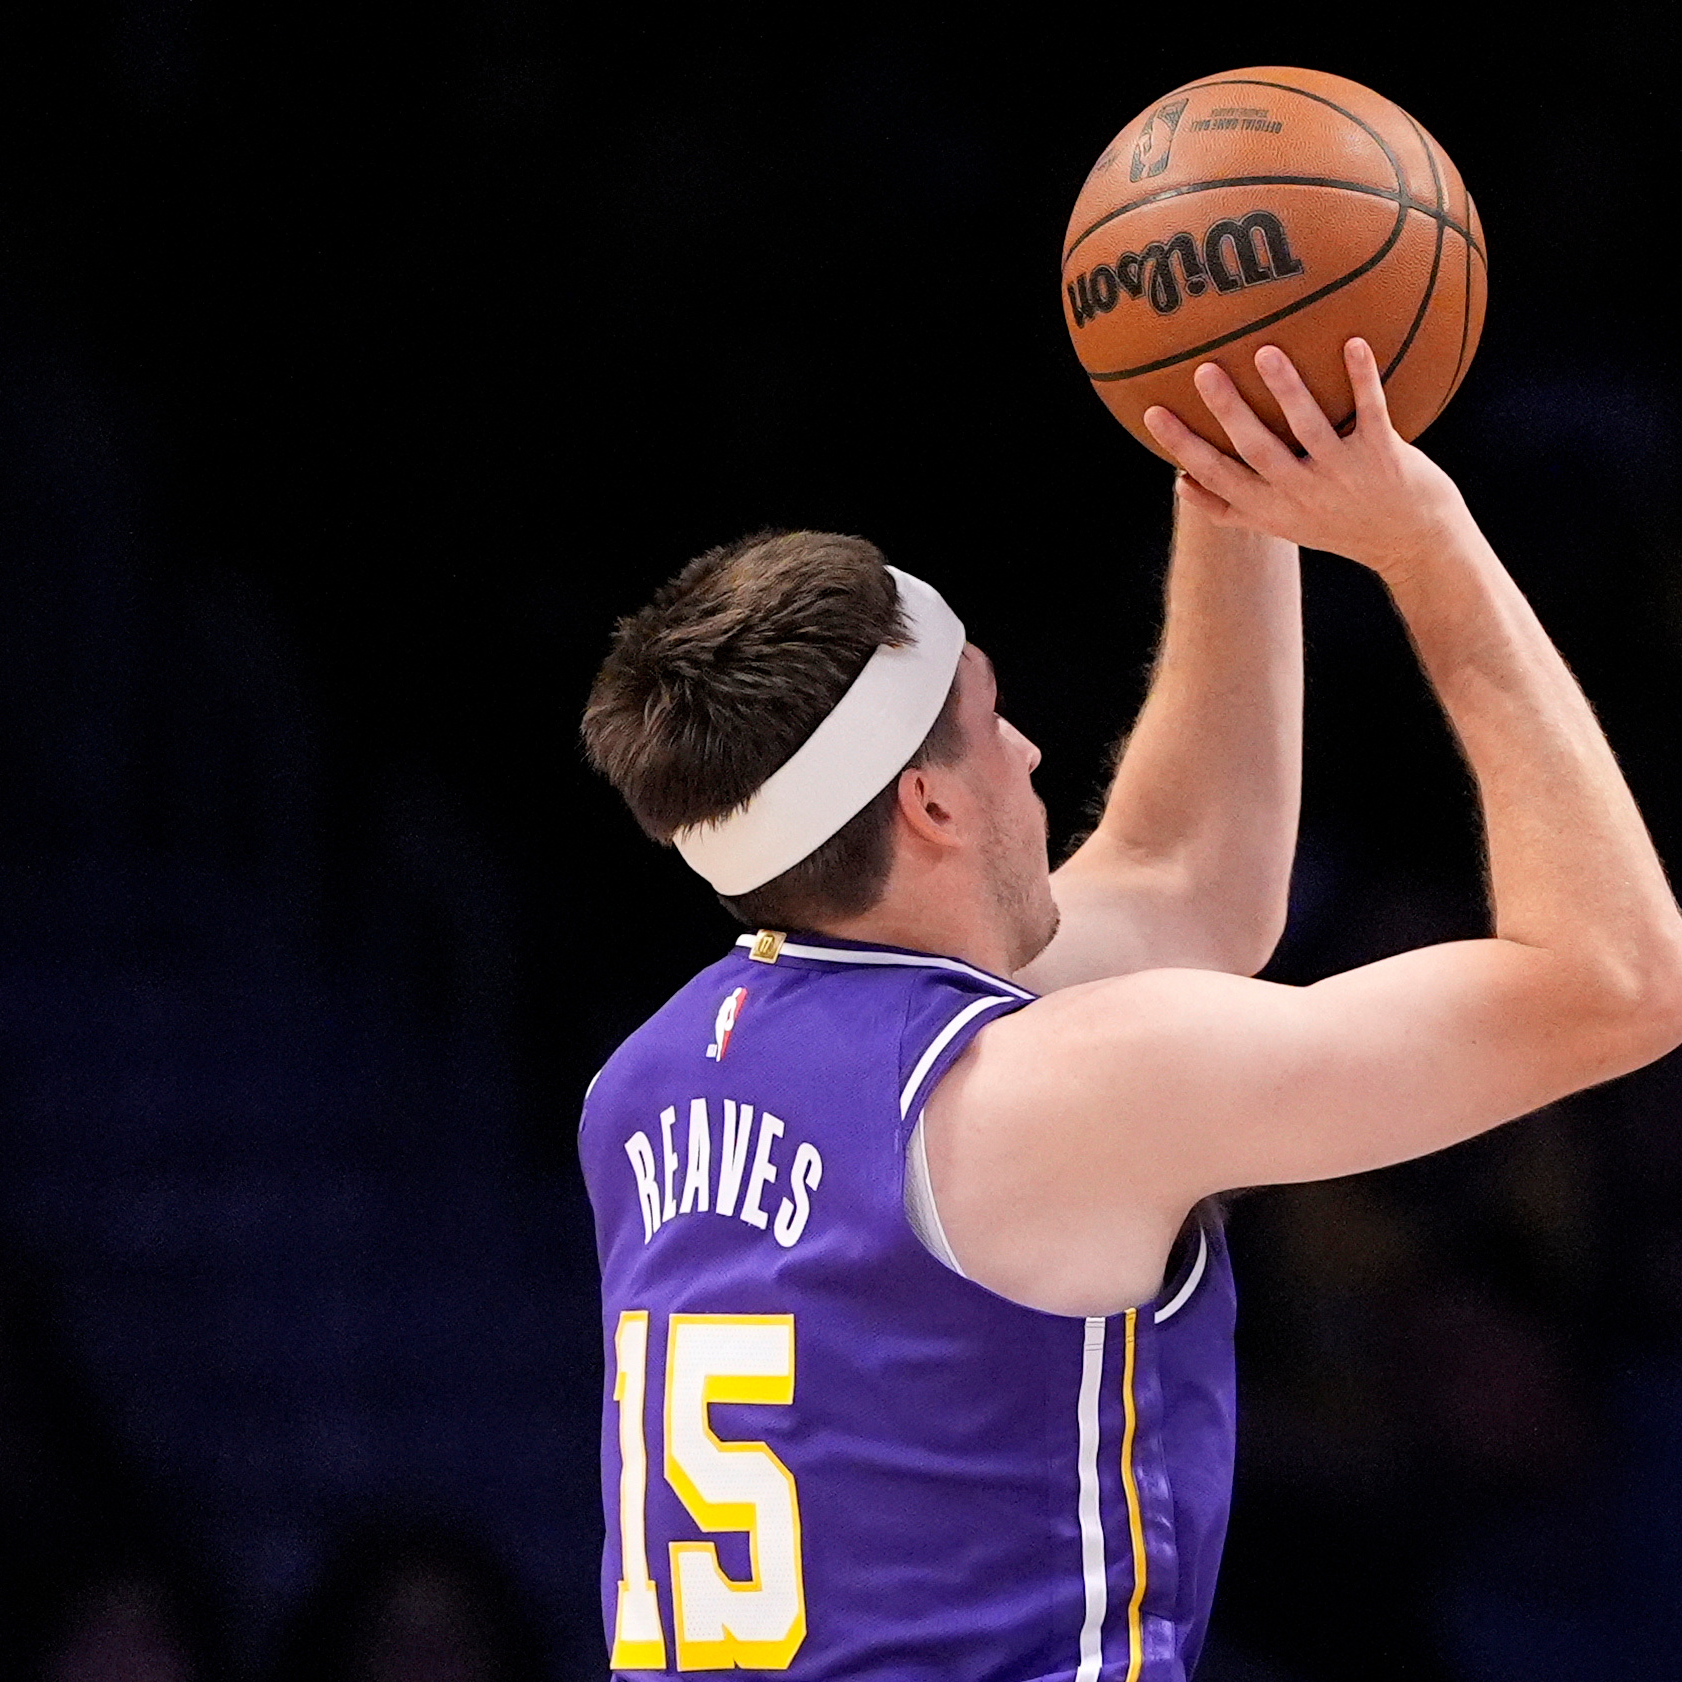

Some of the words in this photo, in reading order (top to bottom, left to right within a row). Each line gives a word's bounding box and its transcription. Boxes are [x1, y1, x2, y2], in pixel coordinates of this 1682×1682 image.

[1067, 210, 1304, 329] Wilson
[625, 1098, 822, 1247] REAVES
[610, 1310, 808, 1671] 15
